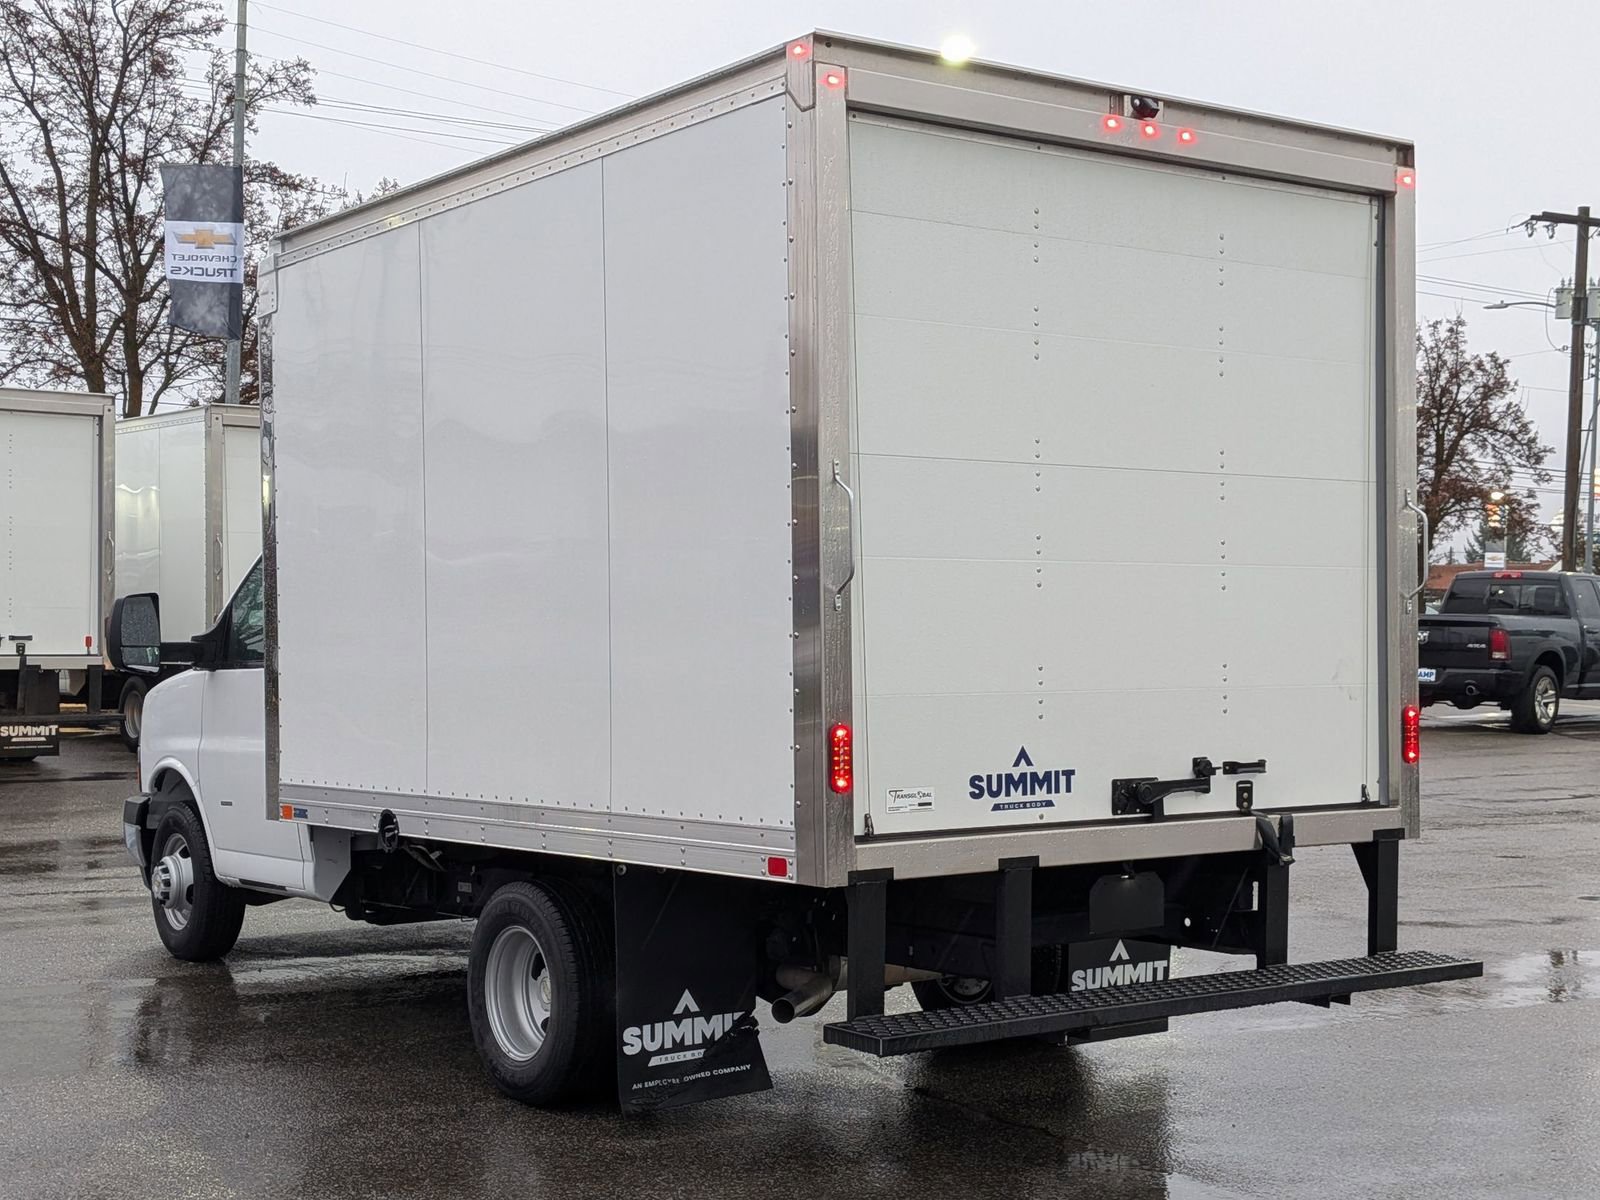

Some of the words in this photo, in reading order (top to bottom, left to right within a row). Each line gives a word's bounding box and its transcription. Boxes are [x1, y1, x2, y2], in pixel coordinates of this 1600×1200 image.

[0, 724, 59, 737] SUMMIT
[968, 769, 1076, 800] SUMMIT
[1071, 960, 1168, 992] SUMMIT
[659, 1053, 687, 1062] TRUCK
[683, 1071, 711, 1082] OWNED
[712, 1063, 751, 1076] COMPANY
